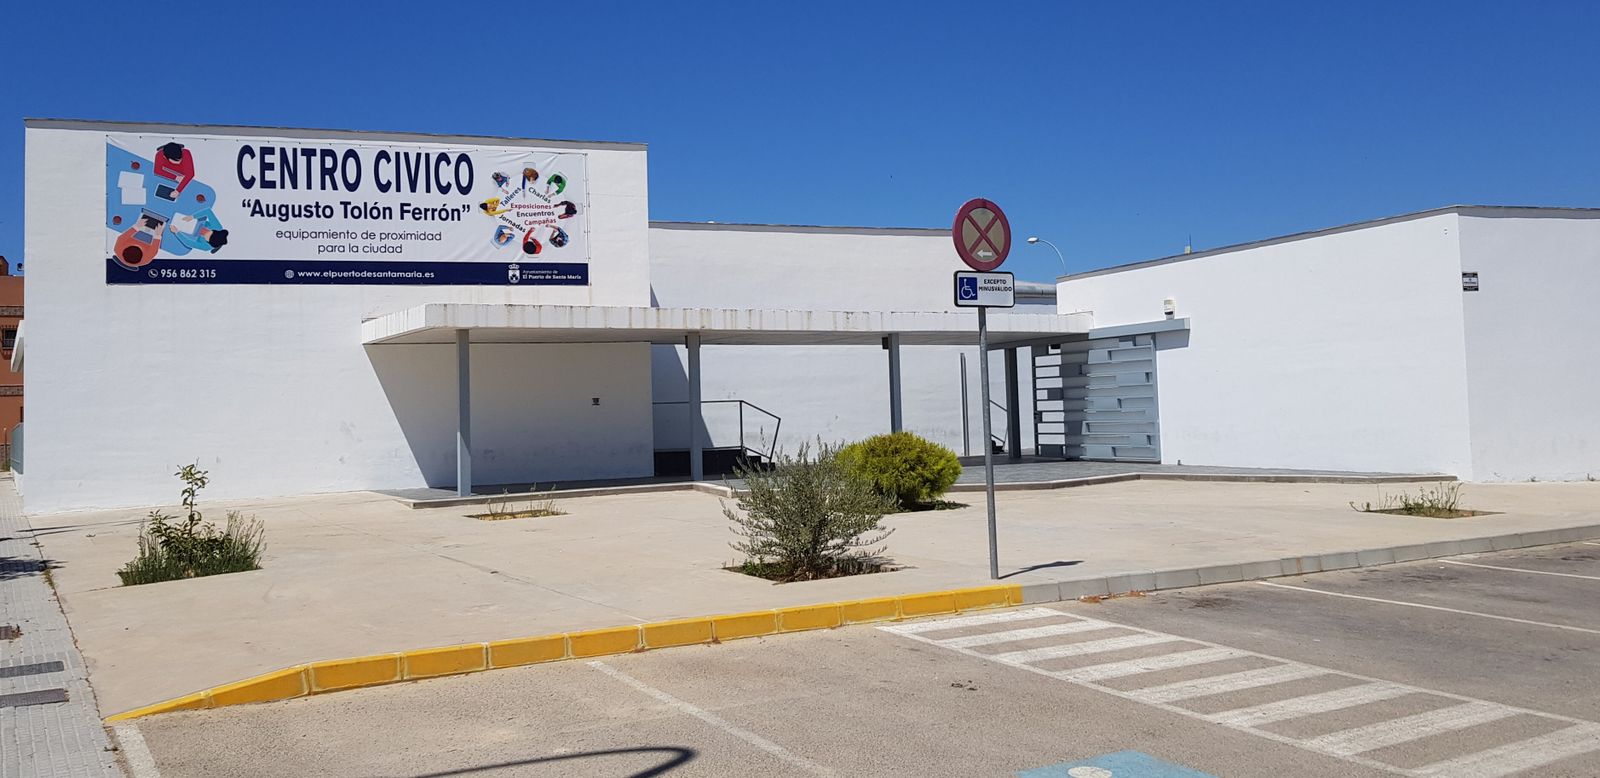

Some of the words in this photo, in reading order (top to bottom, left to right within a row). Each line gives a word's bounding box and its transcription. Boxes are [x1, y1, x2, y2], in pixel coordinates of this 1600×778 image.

[236, 144, 362, 192] CENTRO
[373, 150, 474, 196] CIVICO
[500, 187, 522, 207] Talleres
[528, 187, 551, 204] Charlas
[241, 198, 334, 222] “Augusto
[340, 199, 393, 221] Tolón
[400, 201, 471, 223] Ferrón”
[510, 203, 552, 211] Exposiciones
[499, 214, 527, 233] Jornadas
[524, 217, 557, 226] Campañas
[275, 229, 358, 242] equipamiento
[361, 230, 376, 241] de
[379, 230, 442, 244] proximidad
[317, 243, 345, 256] para
[348, 242, 359, 253] la
[362, 242, 403, 255] ciudad
[160, 269, 178, 278] 956
[179, 269, 197, 278] 862
[199, 269, 216, 278] 315
[297, 269, 435, 279] www.elpuertodesantamaria.es
